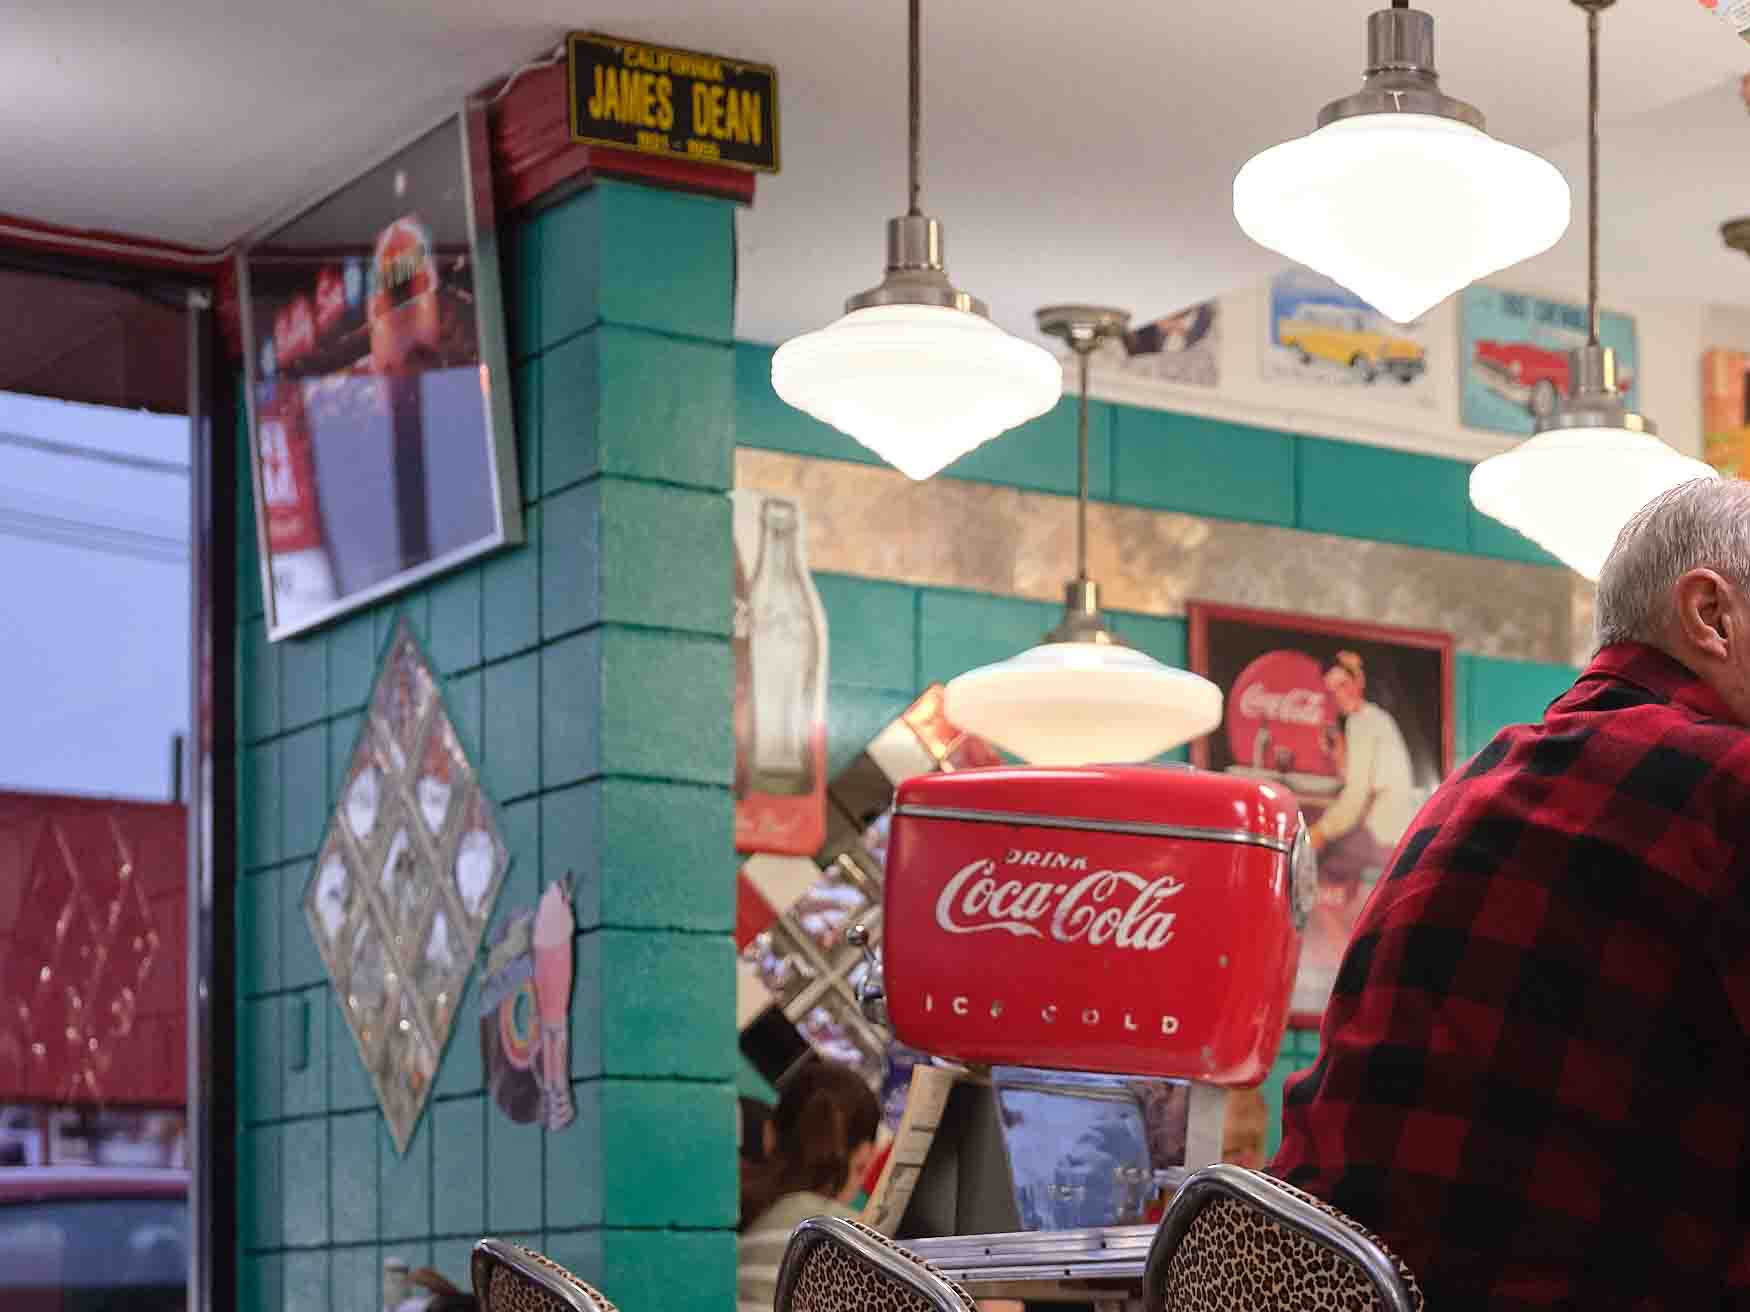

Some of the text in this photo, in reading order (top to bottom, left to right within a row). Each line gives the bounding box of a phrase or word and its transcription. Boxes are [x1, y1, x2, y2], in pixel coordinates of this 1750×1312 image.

[588, 64, 674, 132] JAMES
[691, 81, 762, 146] DEAN
[1004, 849, 1089, 871] DRINK
[935, 858, 1185, 951] Coca-Cola
[1041, 1004, 1180, 1035] COLD
